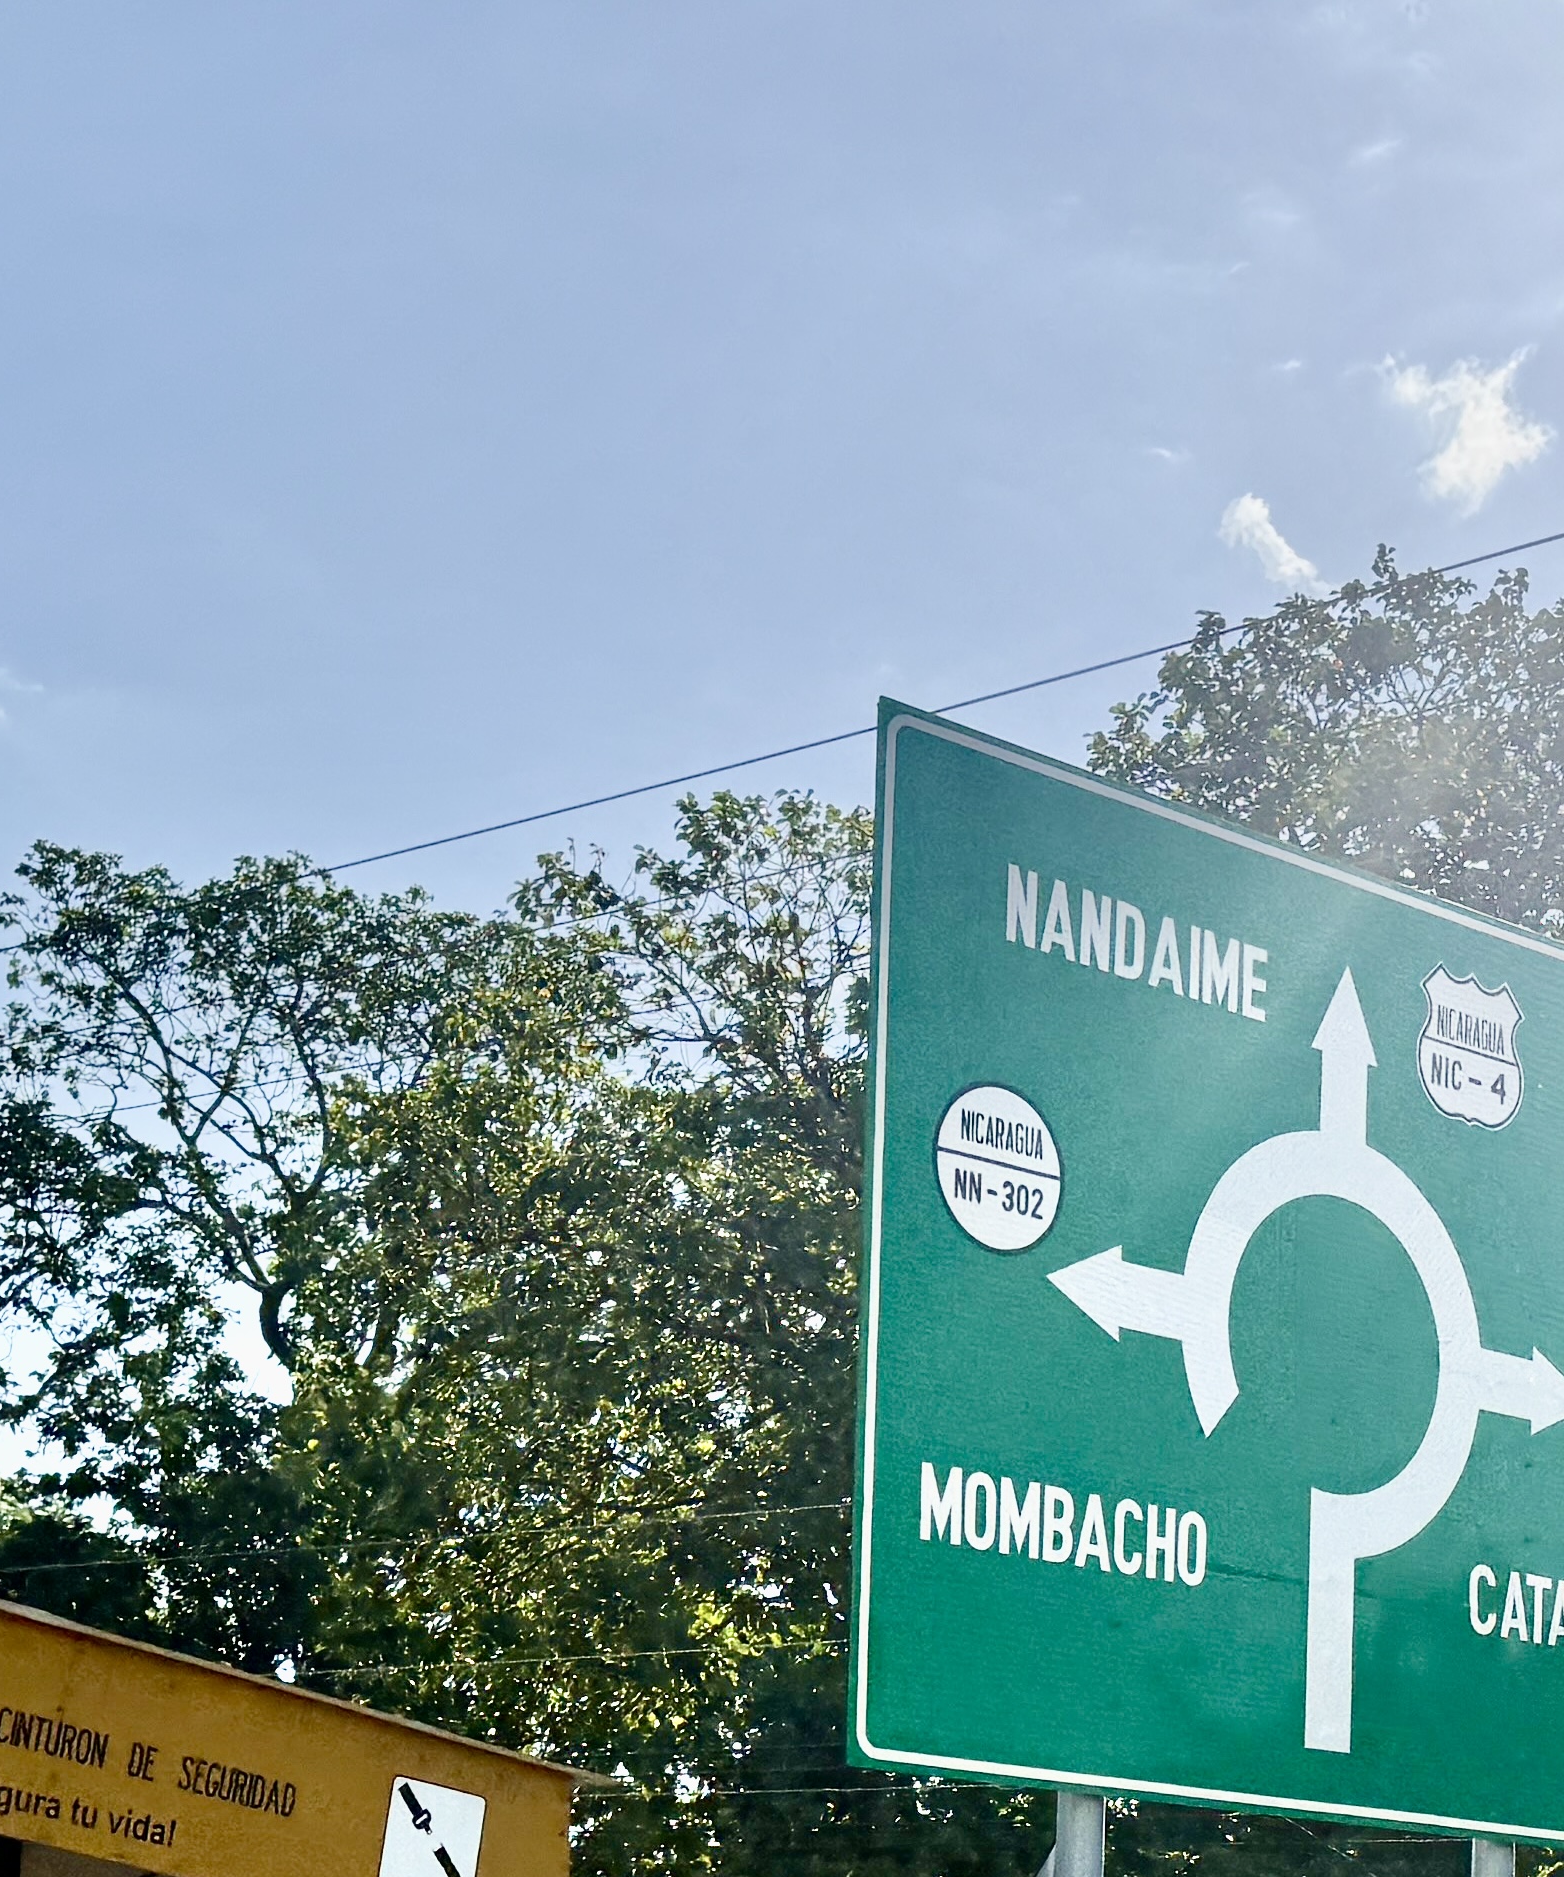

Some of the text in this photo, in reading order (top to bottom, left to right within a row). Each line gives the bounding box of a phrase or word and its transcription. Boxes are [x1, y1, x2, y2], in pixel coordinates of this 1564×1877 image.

[1005, 862, 1269, 1023] NANDAIME
[1436, 1004, 1505, 1056] NICARAGUA
[960, 1107, 1044, 1161] NICARAGUA
[954, 1167, 1044, 1220] NN-302
[919, 1461, 1208, 1588] MOMBACHO
[127, 1742, 158, 1782] DE
[177, 1755, 297, 1817] SEGURIDAD
[71, 1796, 98, 1829] tu
[109, 1808, 177, 1848] vida!
